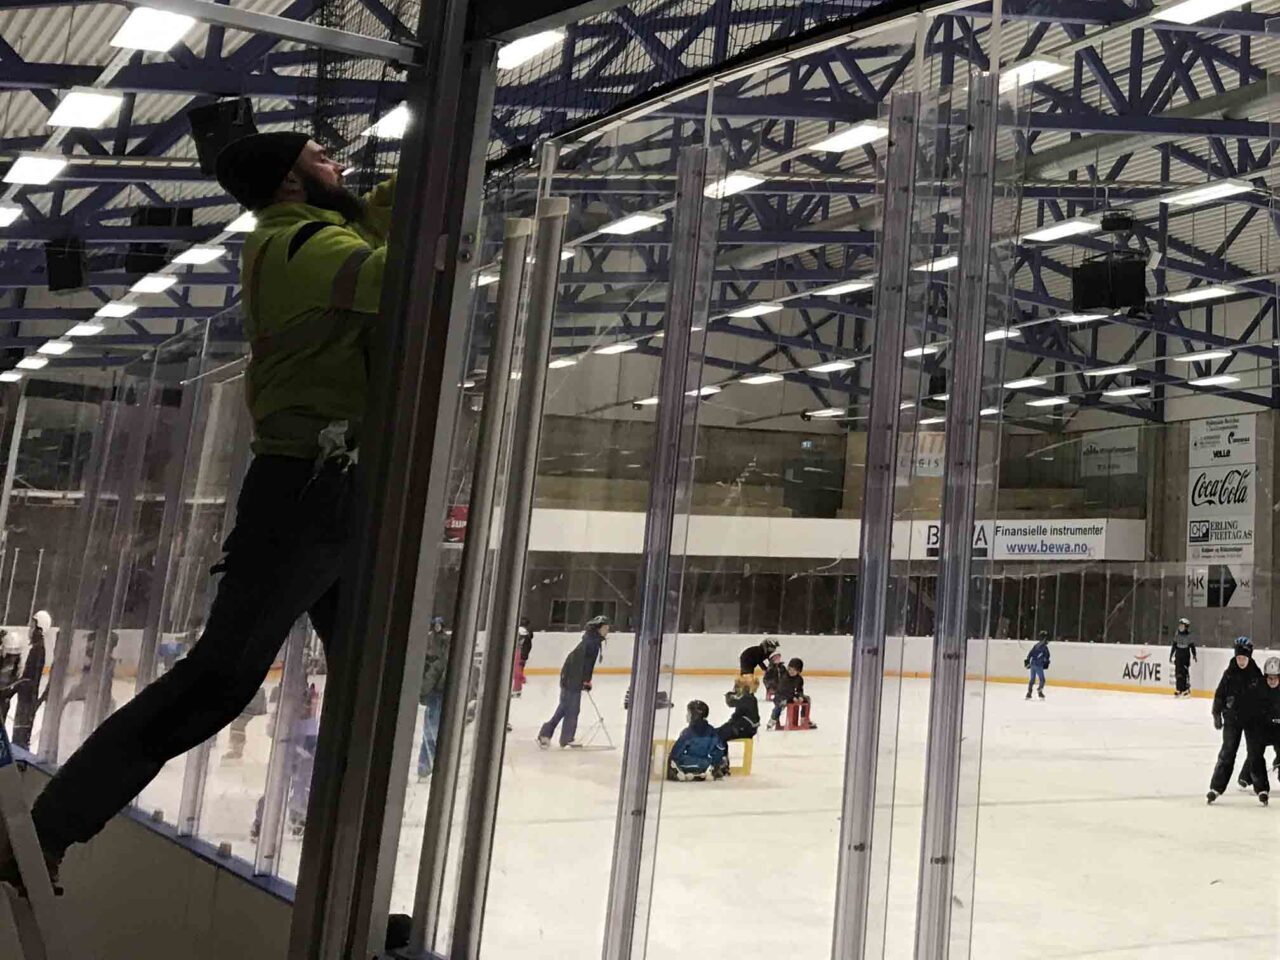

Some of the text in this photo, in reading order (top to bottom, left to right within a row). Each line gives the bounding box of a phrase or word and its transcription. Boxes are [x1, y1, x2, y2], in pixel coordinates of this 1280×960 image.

[1192, 469, 1251, 507] Coca-Cola
[995, 525, 1103, 536] Finansielle instrumenter
[1211, 521, 1238, 531] ERLING
[927, 525, 988, 545] BA
[1006, 540, 1088, 554] www.bewa.no
